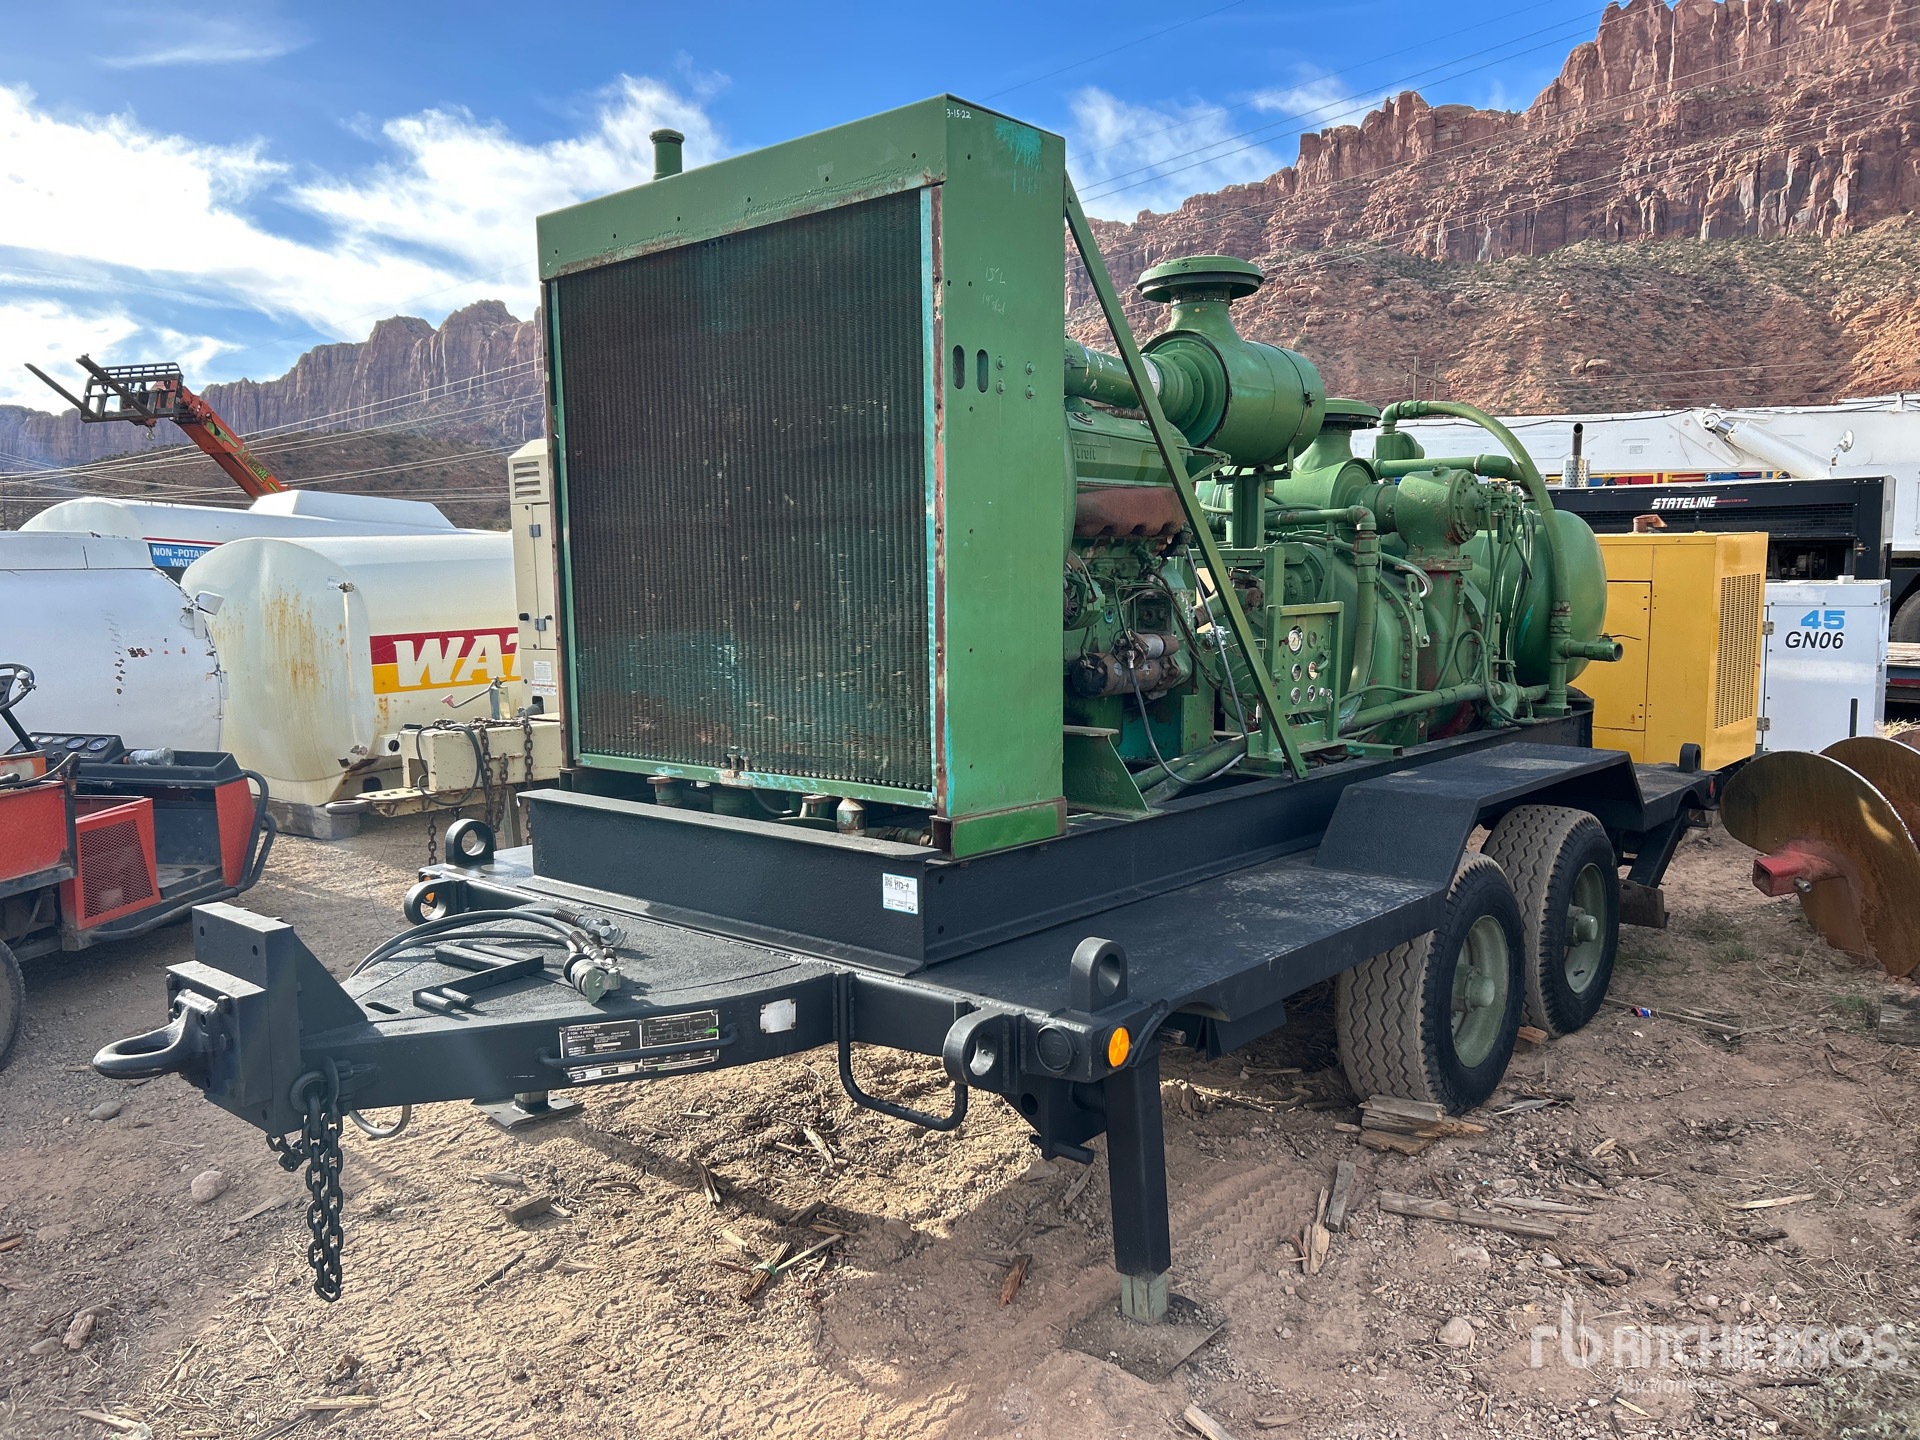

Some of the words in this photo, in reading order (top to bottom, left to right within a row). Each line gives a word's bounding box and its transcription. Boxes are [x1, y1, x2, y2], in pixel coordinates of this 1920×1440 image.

[1651, 496, 1718, 510] STATELINE
[1800, 609, 1846, 630] 45
[1785, 631, 1845, 649] GN06
